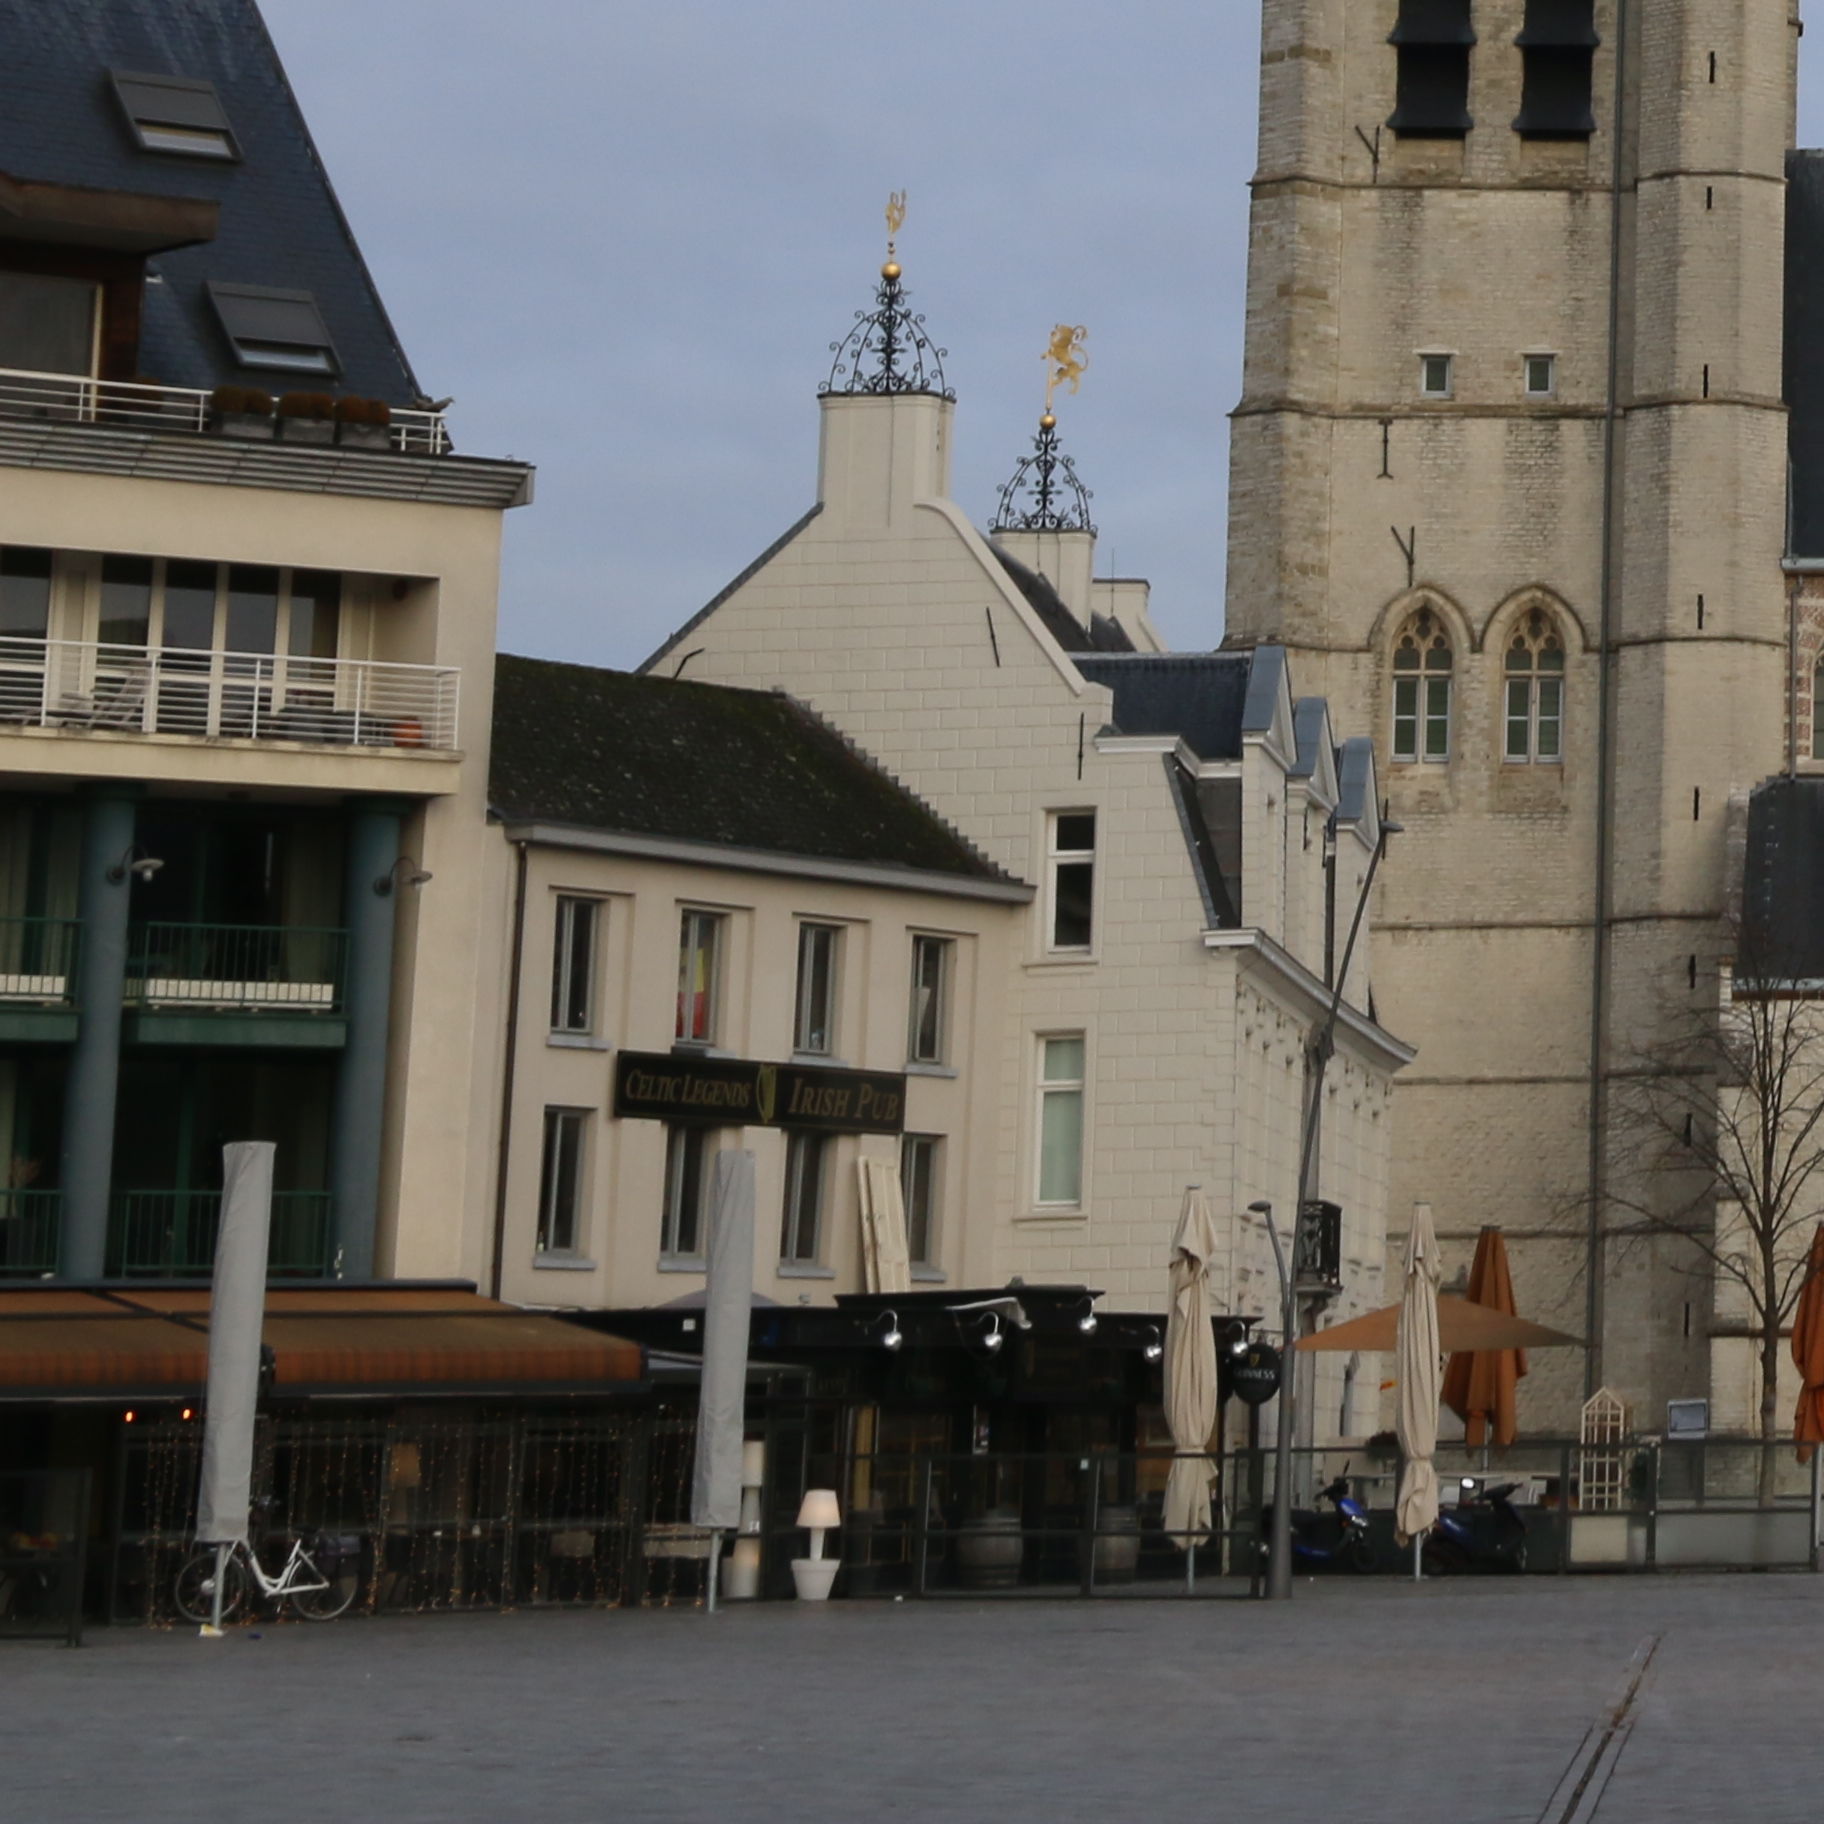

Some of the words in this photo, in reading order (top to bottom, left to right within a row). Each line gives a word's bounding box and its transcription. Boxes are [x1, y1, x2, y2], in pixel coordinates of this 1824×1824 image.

[625, 1068, 679, 1102] CELTIC
[681, 1074, 752, 1108] LEGENDS
[788, 1078, 850, 1119] IRISH
[854, 1082, 898, 1121] PUB
[1233, 1367, 1276, 1380] GUINNESS
